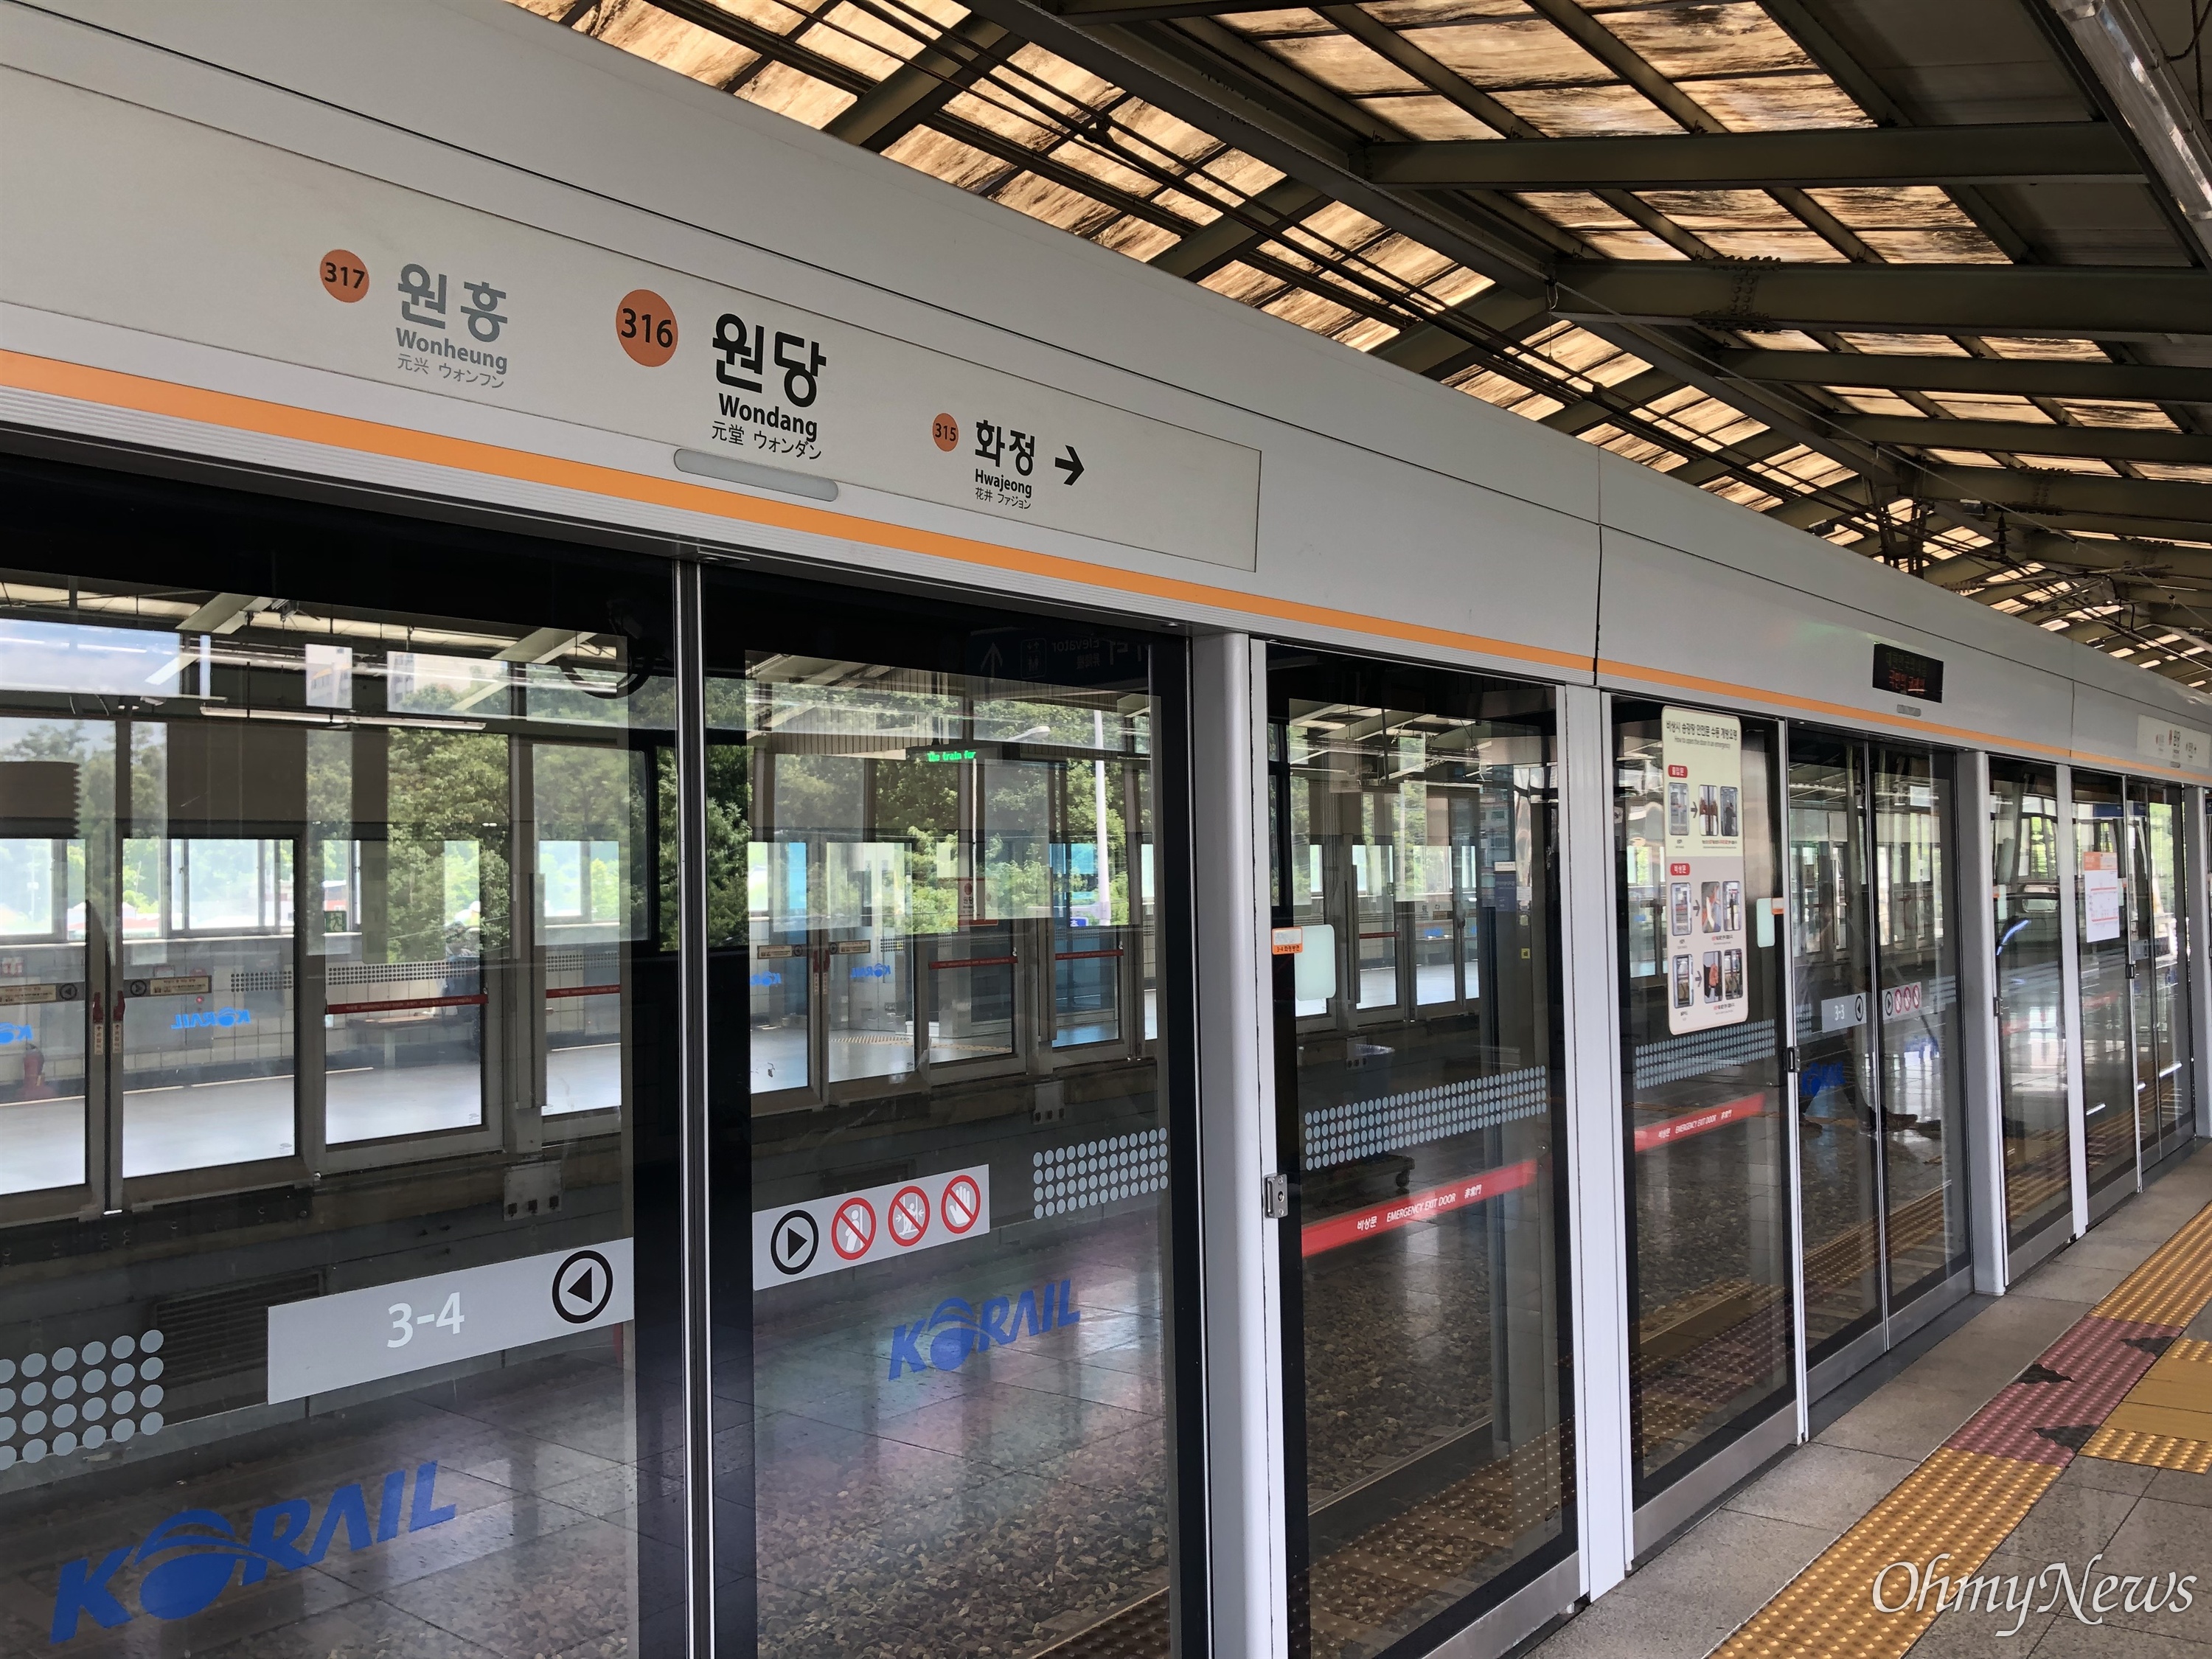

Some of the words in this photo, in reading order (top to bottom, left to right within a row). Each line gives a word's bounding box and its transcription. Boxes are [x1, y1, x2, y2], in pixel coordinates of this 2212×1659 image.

[324, 262, 366, 290] 317
[396, 262, 509, 344] 원흥
[620, 307, 673, 349] 316
[396, 328, 508, 375] Wonheung
[712, 313, 827, 408] 원당
[712, 421, 745, 446] 元堂
[719, 394, 818, 442] Wondang
[935, 423, 956, 442] 315
[975, 420, 1035, 476] 화정
[975, 468, 1032, 498] Hwajeong
[975, 487, 992, 502] 花井
[942, 751, 961, 761] train
[1834, 1004, 1845, 1021] 3-3
[1357, 1215, 1377, 1231] 비상문
[1387, 1202, 1423, 1222] EMERGENCY
[1425, 1198, 1437, 1211] EXIT
[1439, 1193, 1456, 1207] DOOR
[386, 1292, 465, 1349] 3-4
[888, 1279, 1080, 1381] KORAIL
[50, 1460, 456, 1645] KORAIL
